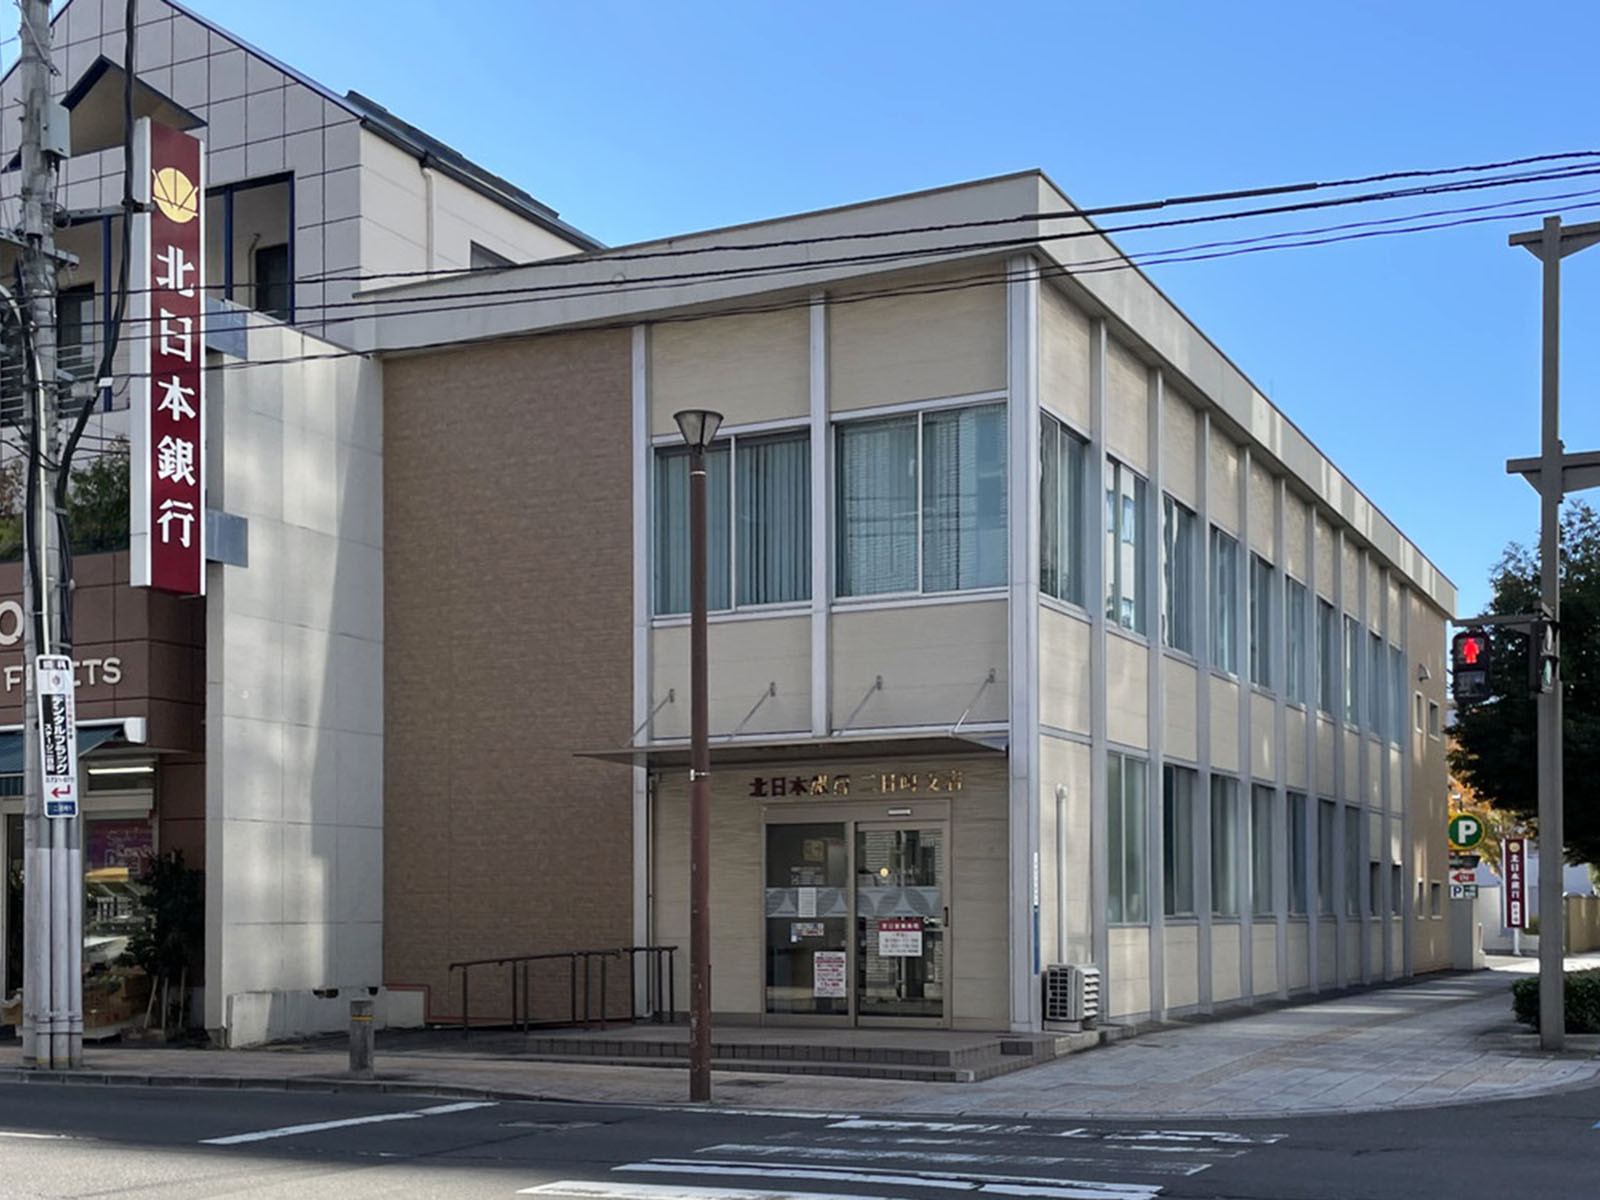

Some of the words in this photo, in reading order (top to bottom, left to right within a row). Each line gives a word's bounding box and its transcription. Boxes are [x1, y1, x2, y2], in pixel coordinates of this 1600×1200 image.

[157, 245, 196, 549] 北日本銀行
[1458, 820, 1477, 844] P
[1453, 885, 1463, 897] P
